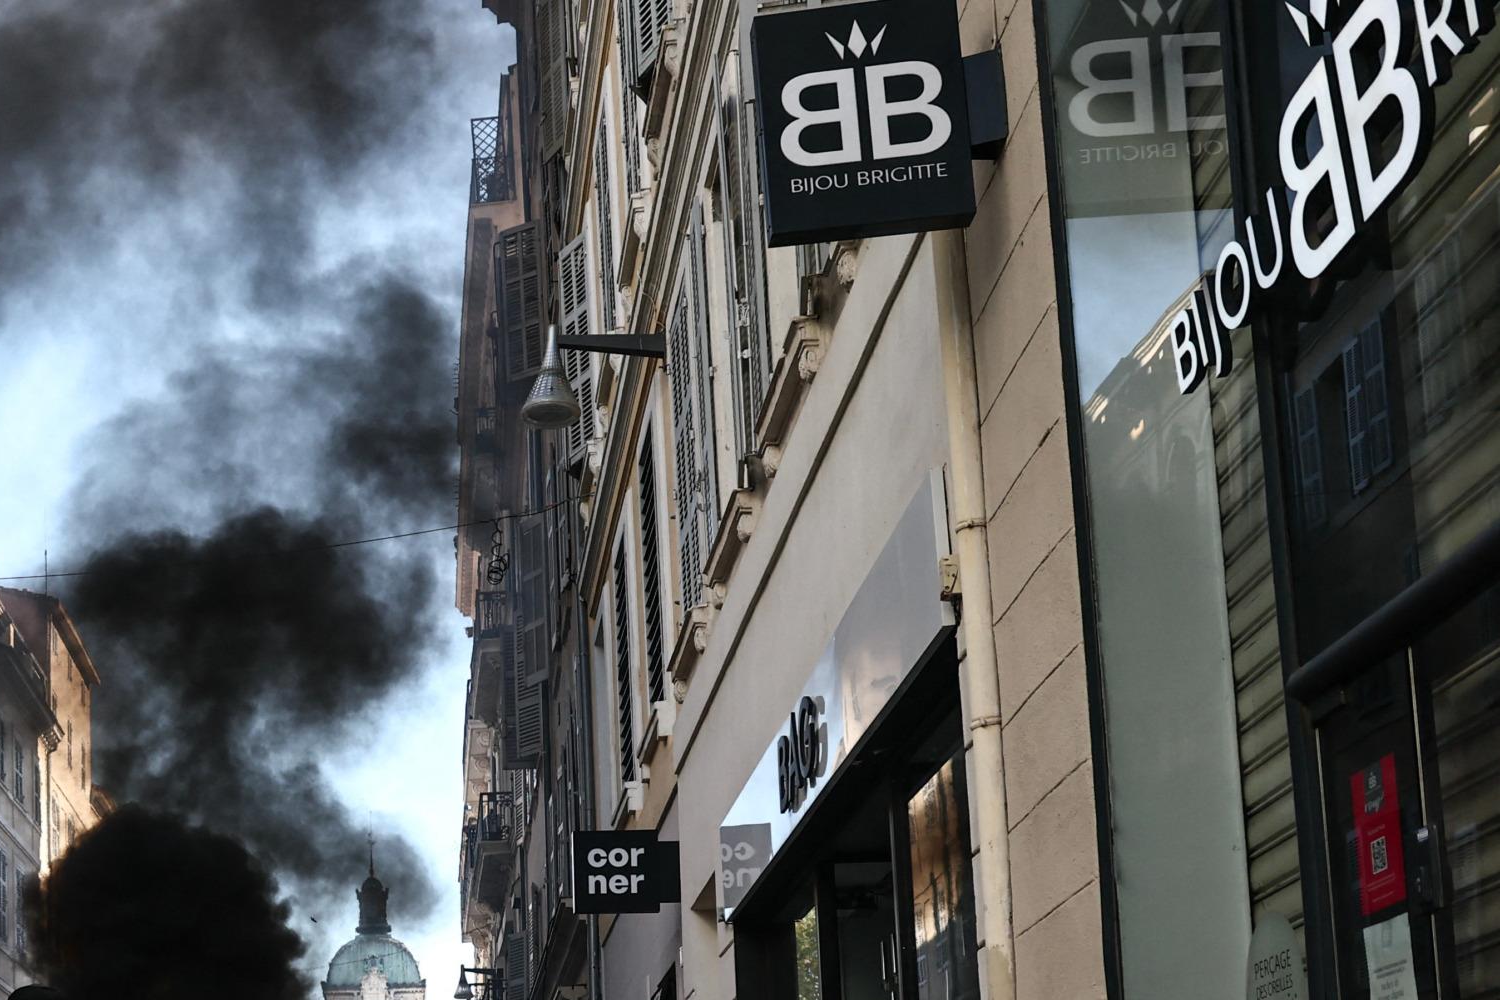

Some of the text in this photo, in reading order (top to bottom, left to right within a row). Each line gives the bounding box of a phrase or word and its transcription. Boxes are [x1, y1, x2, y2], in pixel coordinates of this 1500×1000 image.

[790, 162, 949, 195] BIJOU BRIGITTE
[1170, 187, 1283, 394] BIJOU
[587, 847, 645, 868] cor
[587, 873, 645, 895] ner
[1254, 949, 1291, 980] PERÇAGE
[1256, 974, 1293, 1000] DES OREILLES
